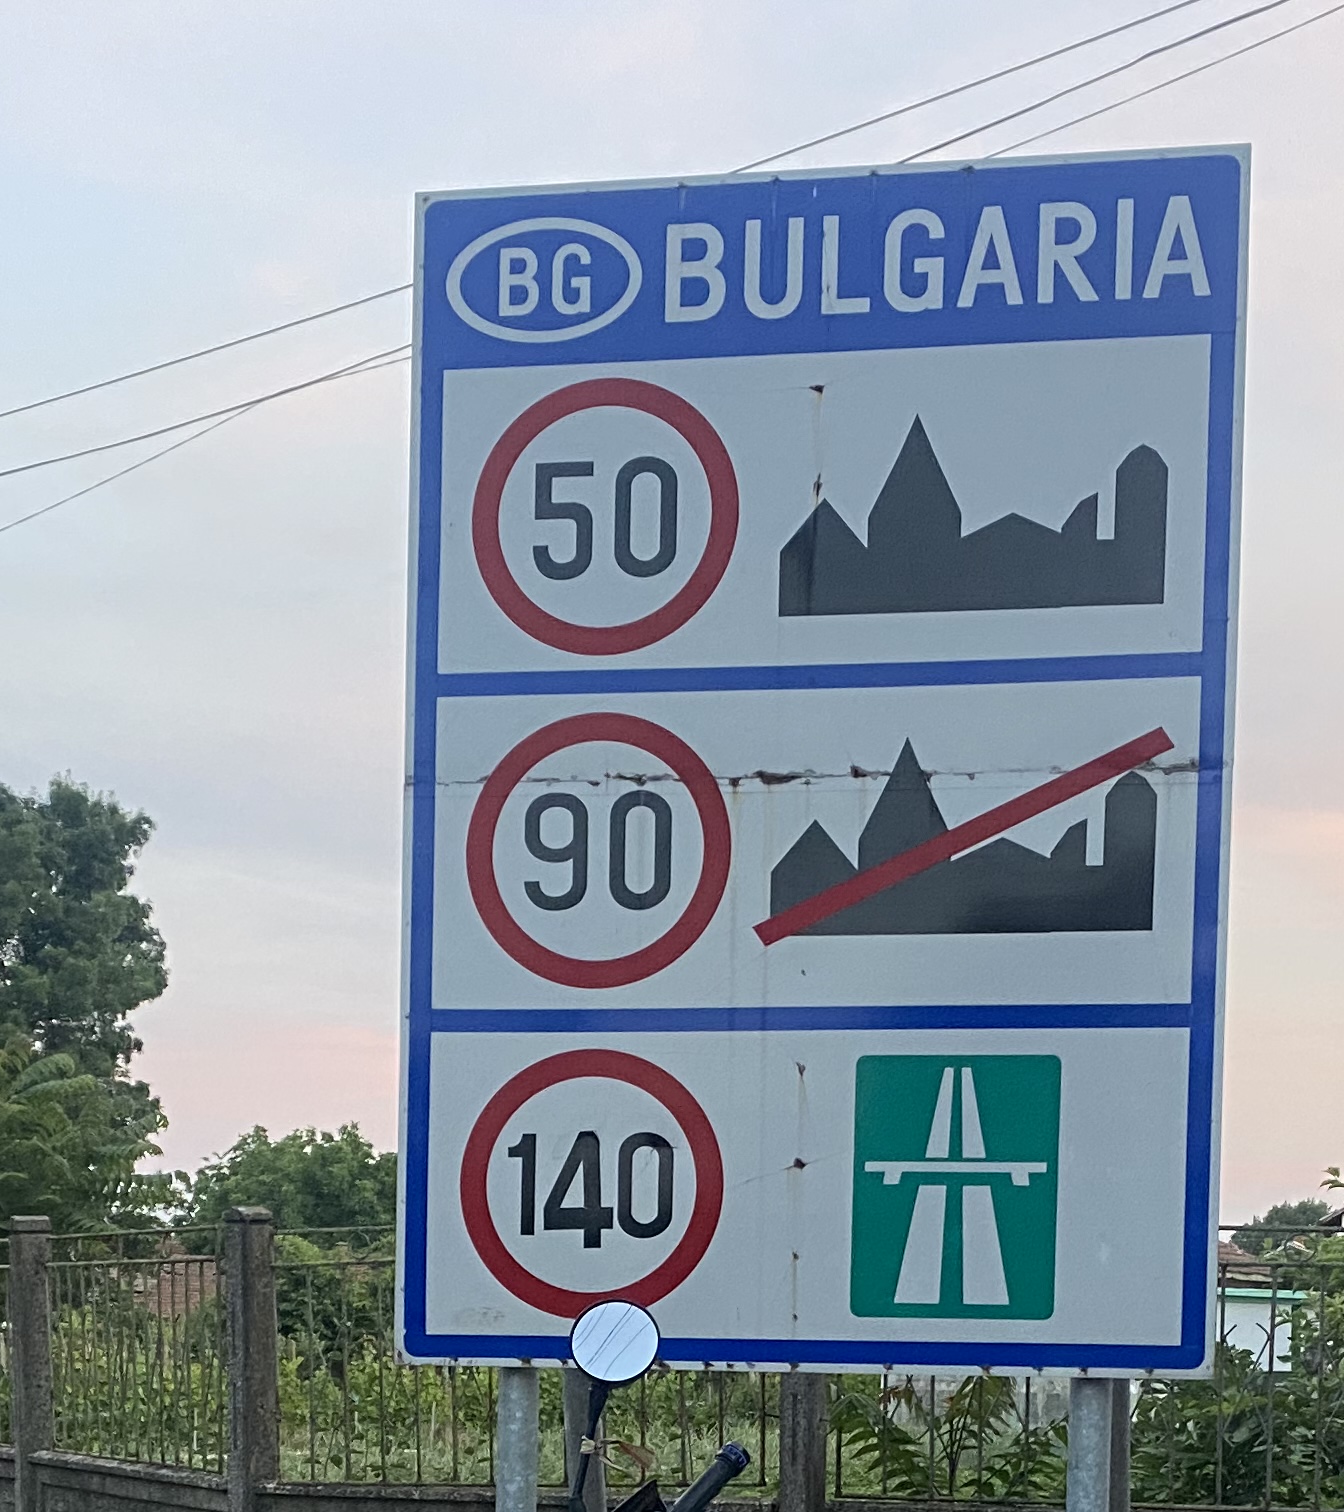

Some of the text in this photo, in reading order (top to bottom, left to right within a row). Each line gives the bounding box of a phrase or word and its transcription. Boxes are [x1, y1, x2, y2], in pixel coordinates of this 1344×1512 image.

[497, 195, 1212, 323] BG BULGARIA
[532, 455, 679, 582] 50
[523, 789, 673, 912] 90
[507, 1130, 677, 1249] 140
